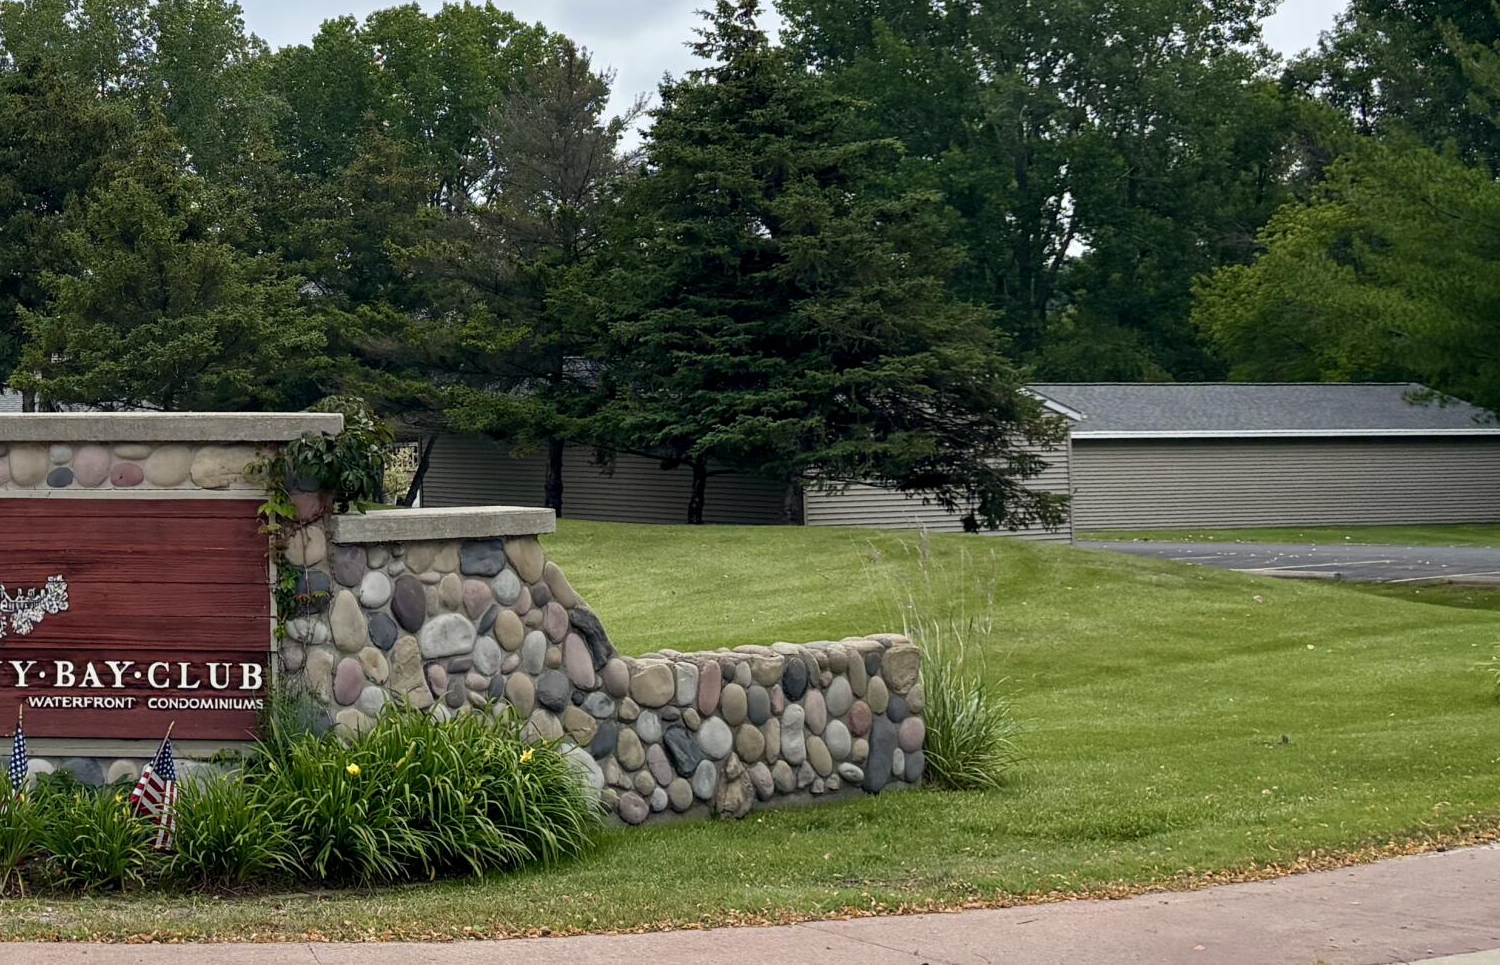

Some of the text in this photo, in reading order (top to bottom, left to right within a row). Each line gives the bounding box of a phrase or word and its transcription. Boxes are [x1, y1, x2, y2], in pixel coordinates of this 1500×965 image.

[53, 660, 135, 688] BAY
[147, 661, 263, 690] CLUB
[28, 695, 264, 710] WATERFRONT CONDOMINIUMS
